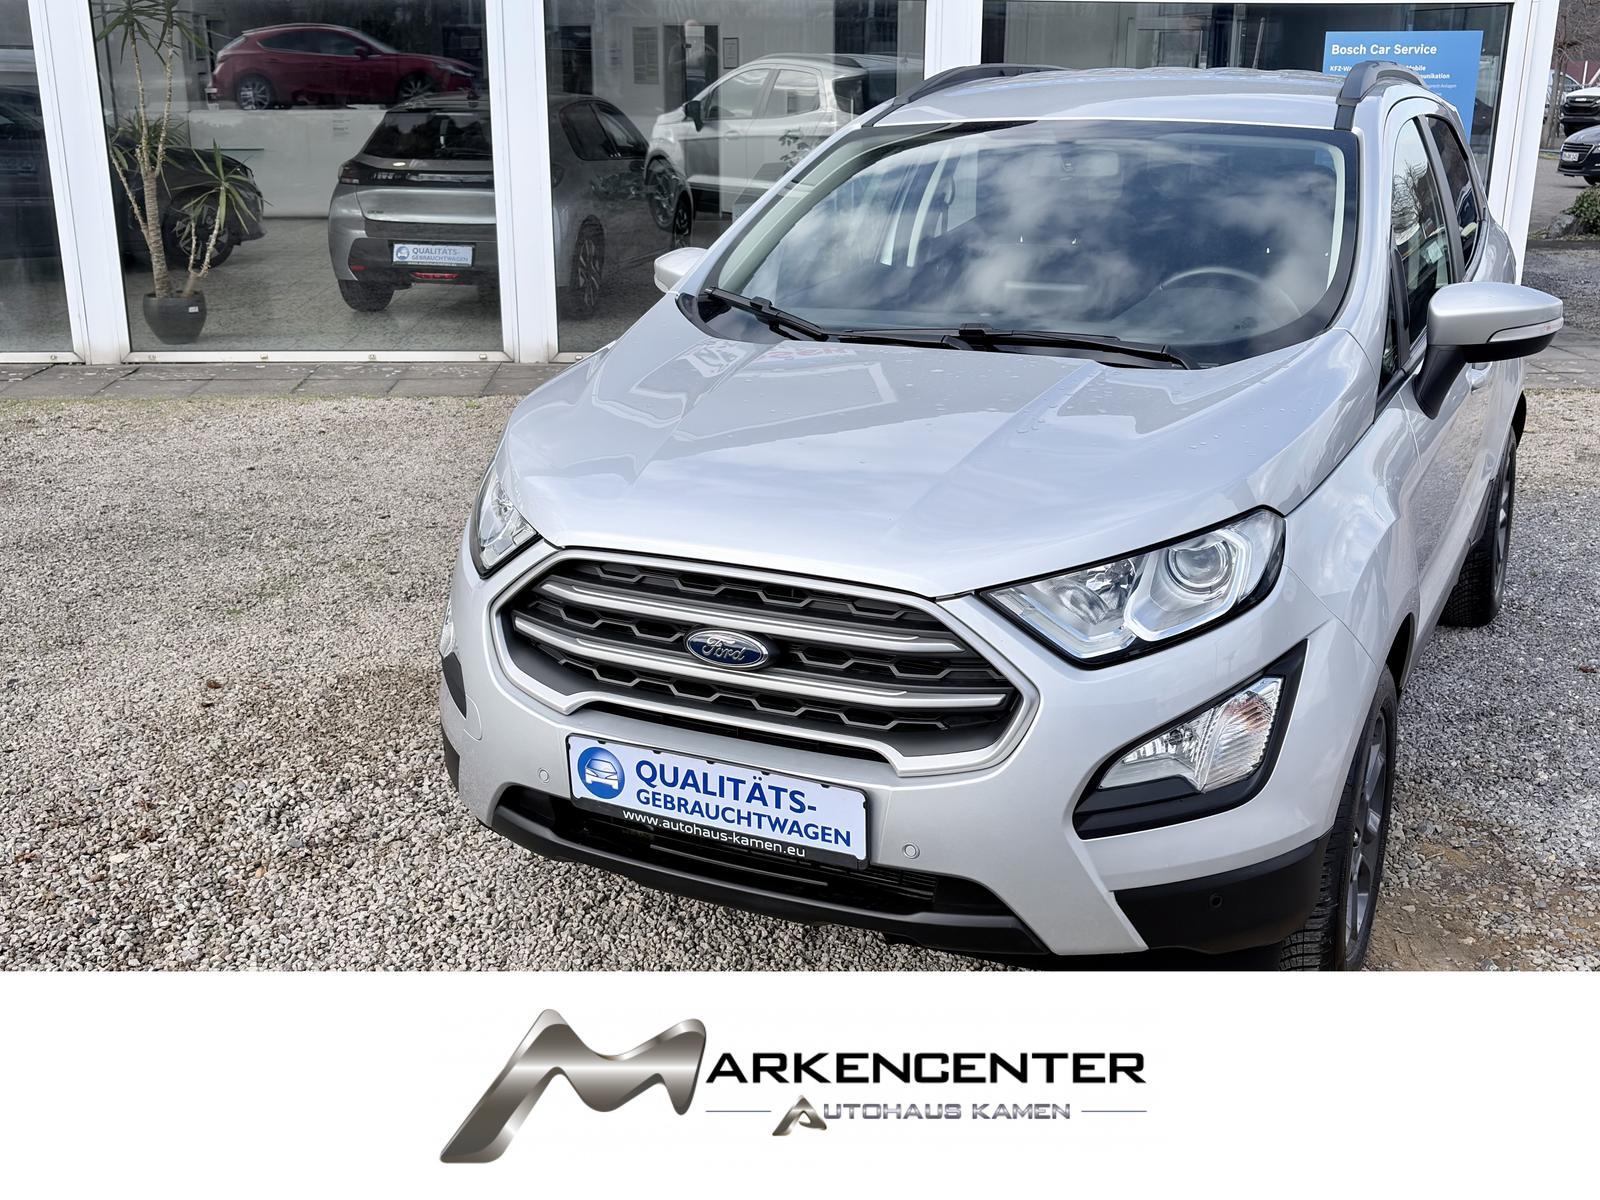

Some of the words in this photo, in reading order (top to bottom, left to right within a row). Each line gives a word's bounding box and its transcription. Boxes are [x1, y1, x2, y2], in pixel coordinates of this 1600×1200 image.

[1331, 43, 1367, 55] Bosch
[1370, 44, 1391, 55] Car
[1393, 43, 1438, 55] Service
[702, 636, 746, 661] Ford
[635, 759, 817, 814] QUALITÄTS-
[622, 809, 806, 858] www.autohaus-kamen.eu
[636, 788, 851, 847] GEBRAUCHTWAGEN
